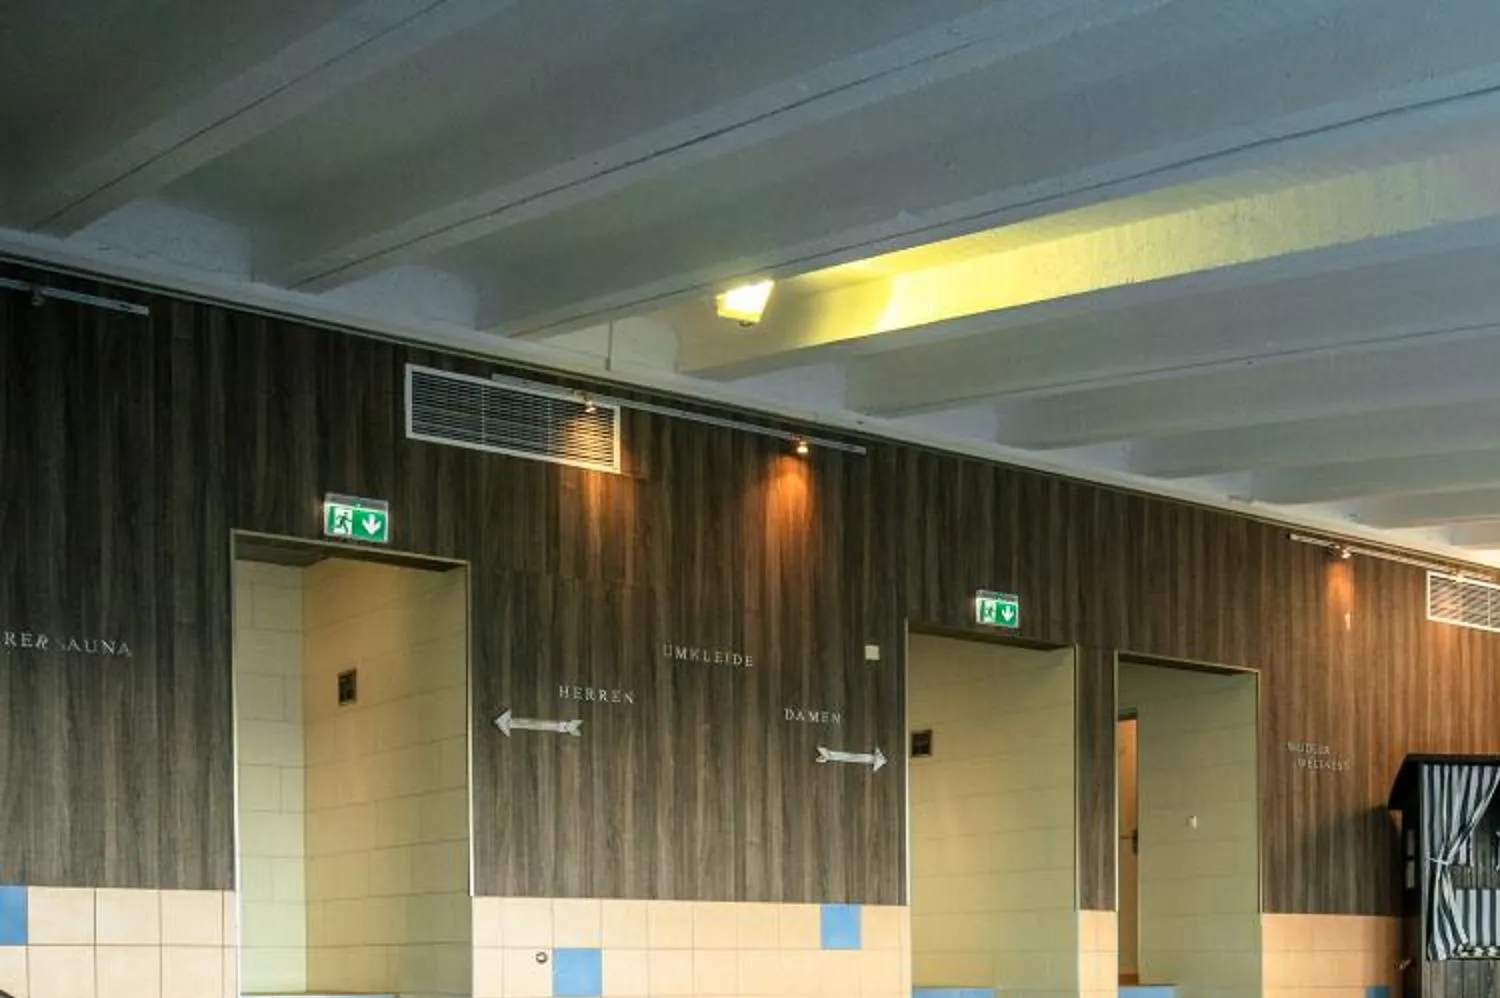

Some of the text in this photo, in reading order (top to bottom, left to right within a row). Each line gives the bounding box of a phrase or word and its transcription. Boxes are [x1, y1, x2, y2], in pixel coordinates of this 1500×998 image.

[664, 644, 754, 667] UMKLEIDE
[559, 685, 634, 704] HERREN
[784, 707, 841, 725] DAMEN
